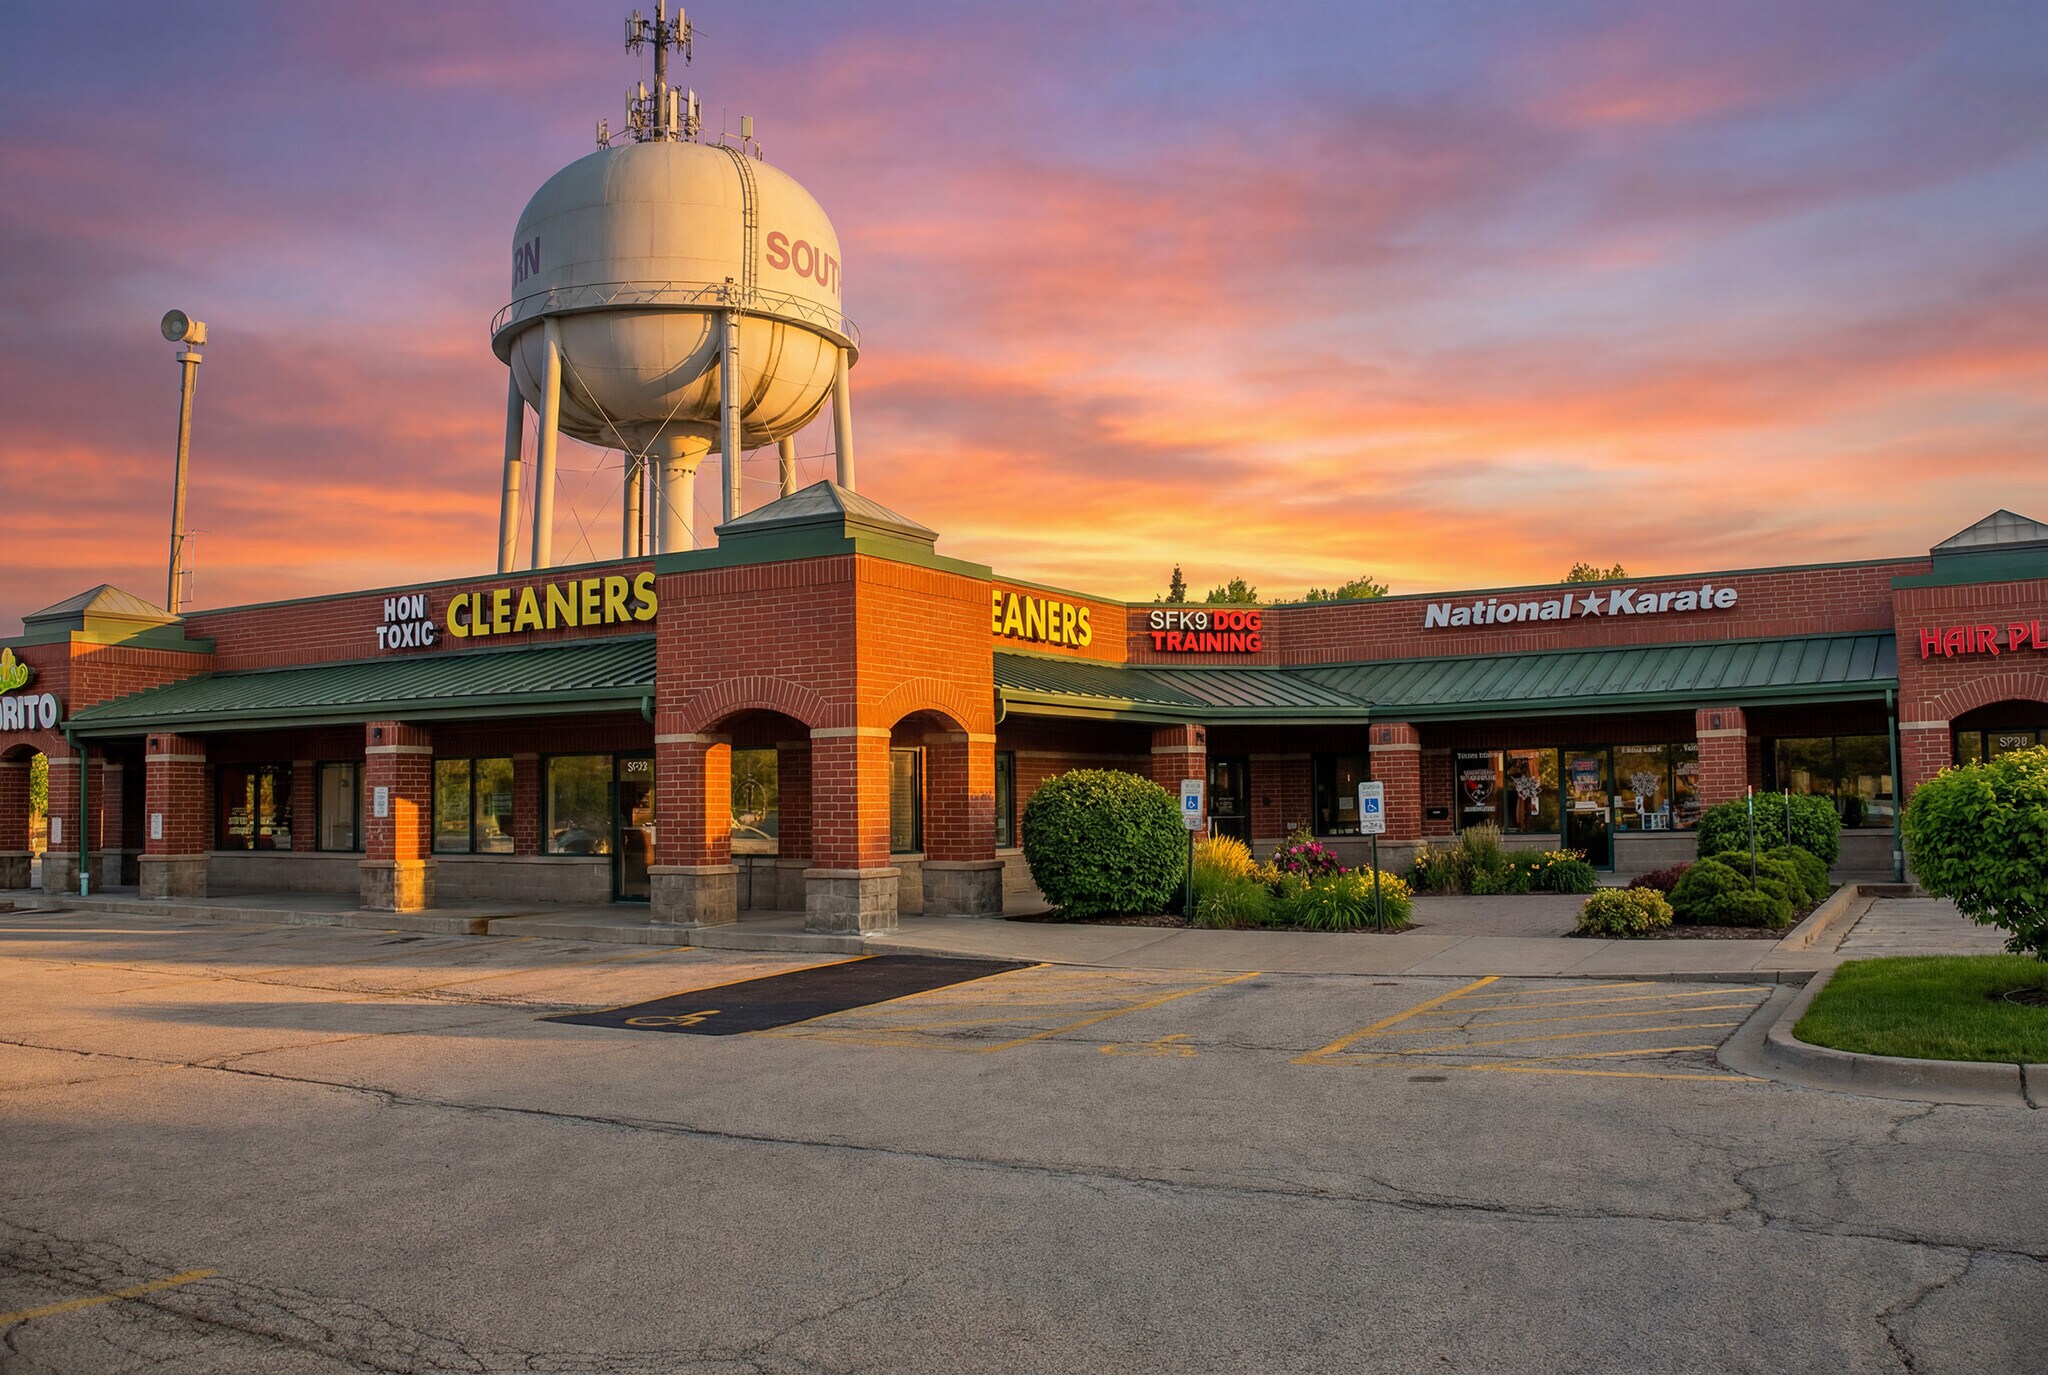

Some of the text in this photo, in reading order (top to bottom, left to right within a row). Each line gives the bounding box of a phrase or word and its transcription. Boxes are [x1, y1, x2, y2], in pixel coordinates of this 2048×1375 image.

[446, 571, 659, 638] CLEANERS
[992, 589, 1092, 647] EANERS
[1149, 610, 1262, 631] SFK9 DOG
[1424, 584, 1739, 629] National Karate
[376, 620, 434, 650] TOXIC
[1151, 631, 1262, 653] TRAINING
[1920, 624, 2000, 660] HAIR
[0, 692, 58, 731] RITO
